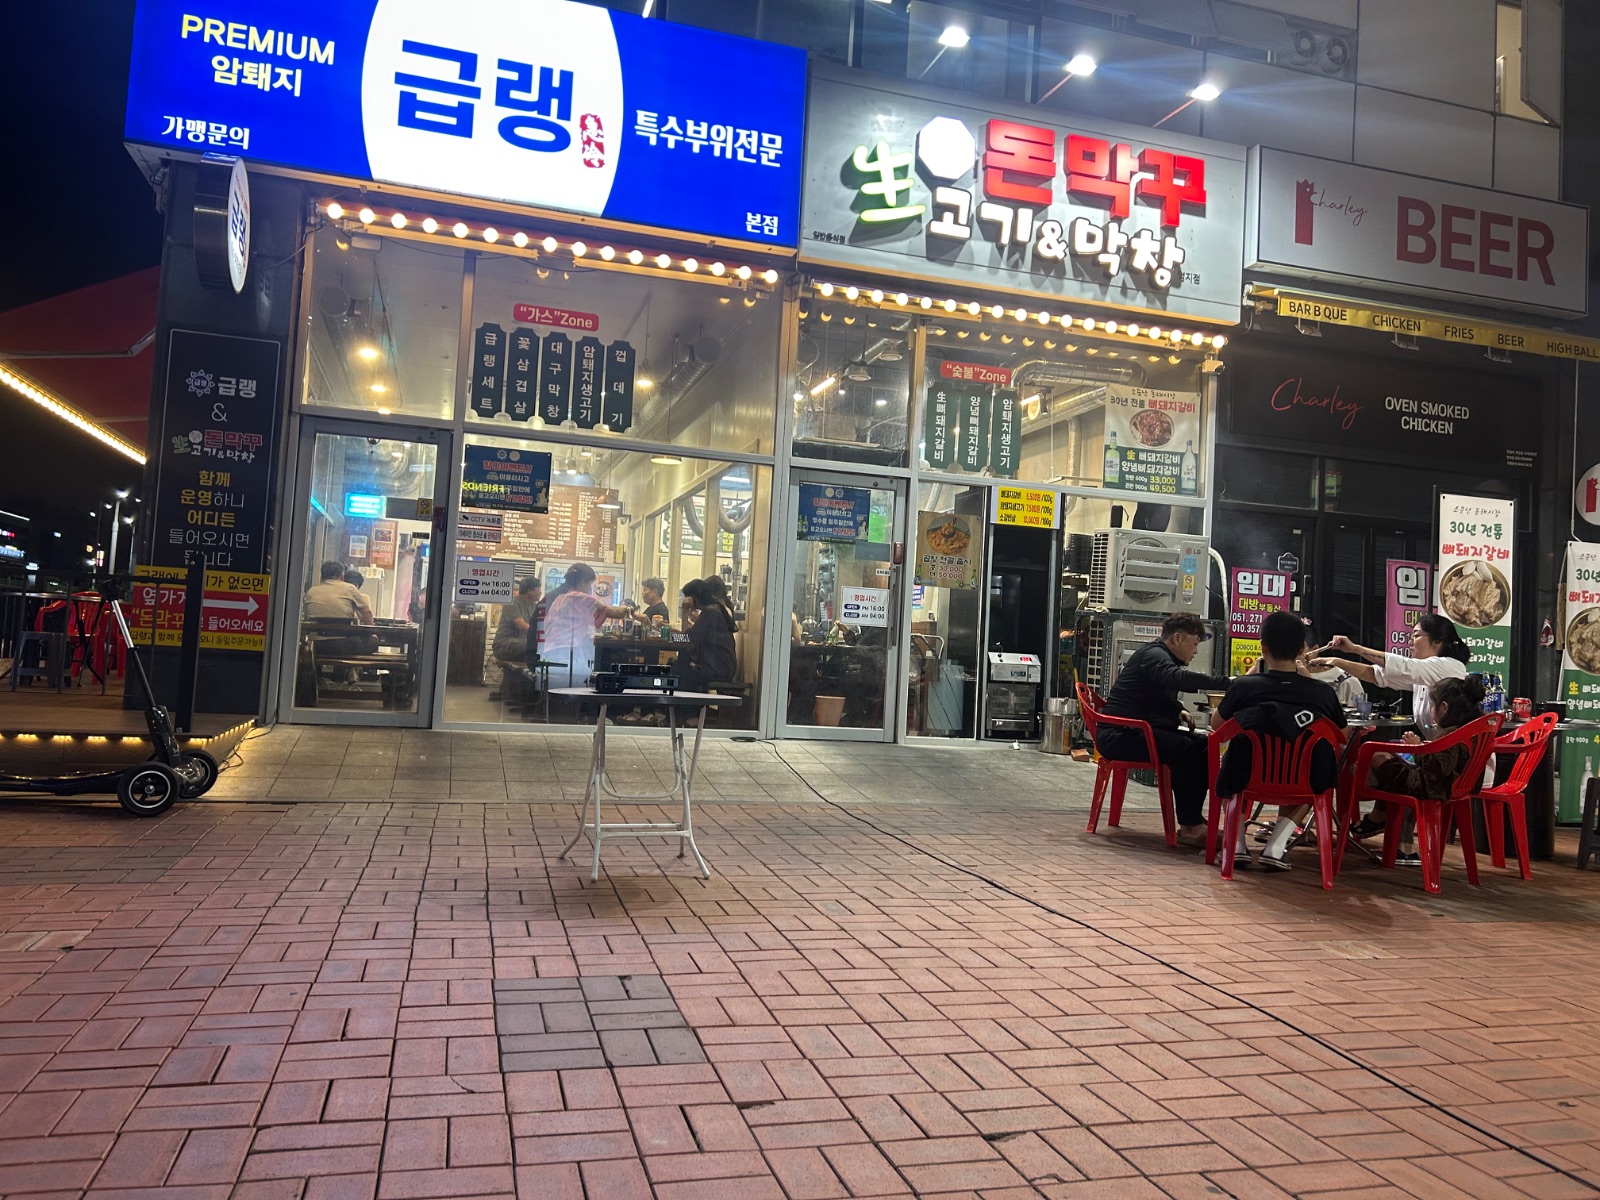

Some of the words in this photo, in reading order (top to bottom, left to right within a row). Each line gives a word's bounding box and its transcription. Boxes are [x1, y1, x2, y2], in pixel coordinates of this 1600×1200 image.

[181, 14, 336, 66] PREMIUM
[211, 55, 303, 98] 암퇘지
[395, 39, 575, 152] 급랭
[161, 114, 251, 150] 가맹문의
[634, 109, 784, 168] 특수부위전문
[853, 140, 926, 223] 生
[982, 117, 1207, 228] 돈막꾸
[744, 211, 780, 236] 본점
[1396, 195, 1557, 287] BEER
[1372, 314, 1422, 332] CHICKEN
[1443, 325, 1475, 340] FRIES
[1497, 334, 1525, 348] BEER
[480, 332, 498, 410] 급랭세트
[546, 342, 563, 418] 대구막창
[218, 376, 257, 398] 급랭
[579, 345, 596, 422] 암퇘지생고기
[611, 350, 627, 426] 껍데기
[211, 403, 228, 422] &
[1271, 378, 1364, 430] Charley
[1385, 396, 1419, 415] OVEN
[1420, 400, 1470, 420] SMOKED
[1401, 416, 1454, 435] CHICKEN
[204, 429, 263, 452] 돈막꾸
[198, 470, 231, 488] 함께
[180, 489, 245, 509] 운영하니
[187, 510, 236, 528] 어디든
[1450, 521, 1477, 536] 30년
[1480, 523, 1503, 540] 전통
[168, 528, 250, 549] 들어오시면
[1442, 543, 1510, 562] 뼈돼지갈비
[228, 575, 264, 591] 없으면
[471, 568, 500, 577] 영업시간
[1237, 571, 1286, 597] 임대
[208, 616, 264, 632] 들어오세요
[1232, 612, 1263, 624] 051.271
[1232, 624, 1260, 634] 010.357
[1391, 632, 1412, 644] 051
